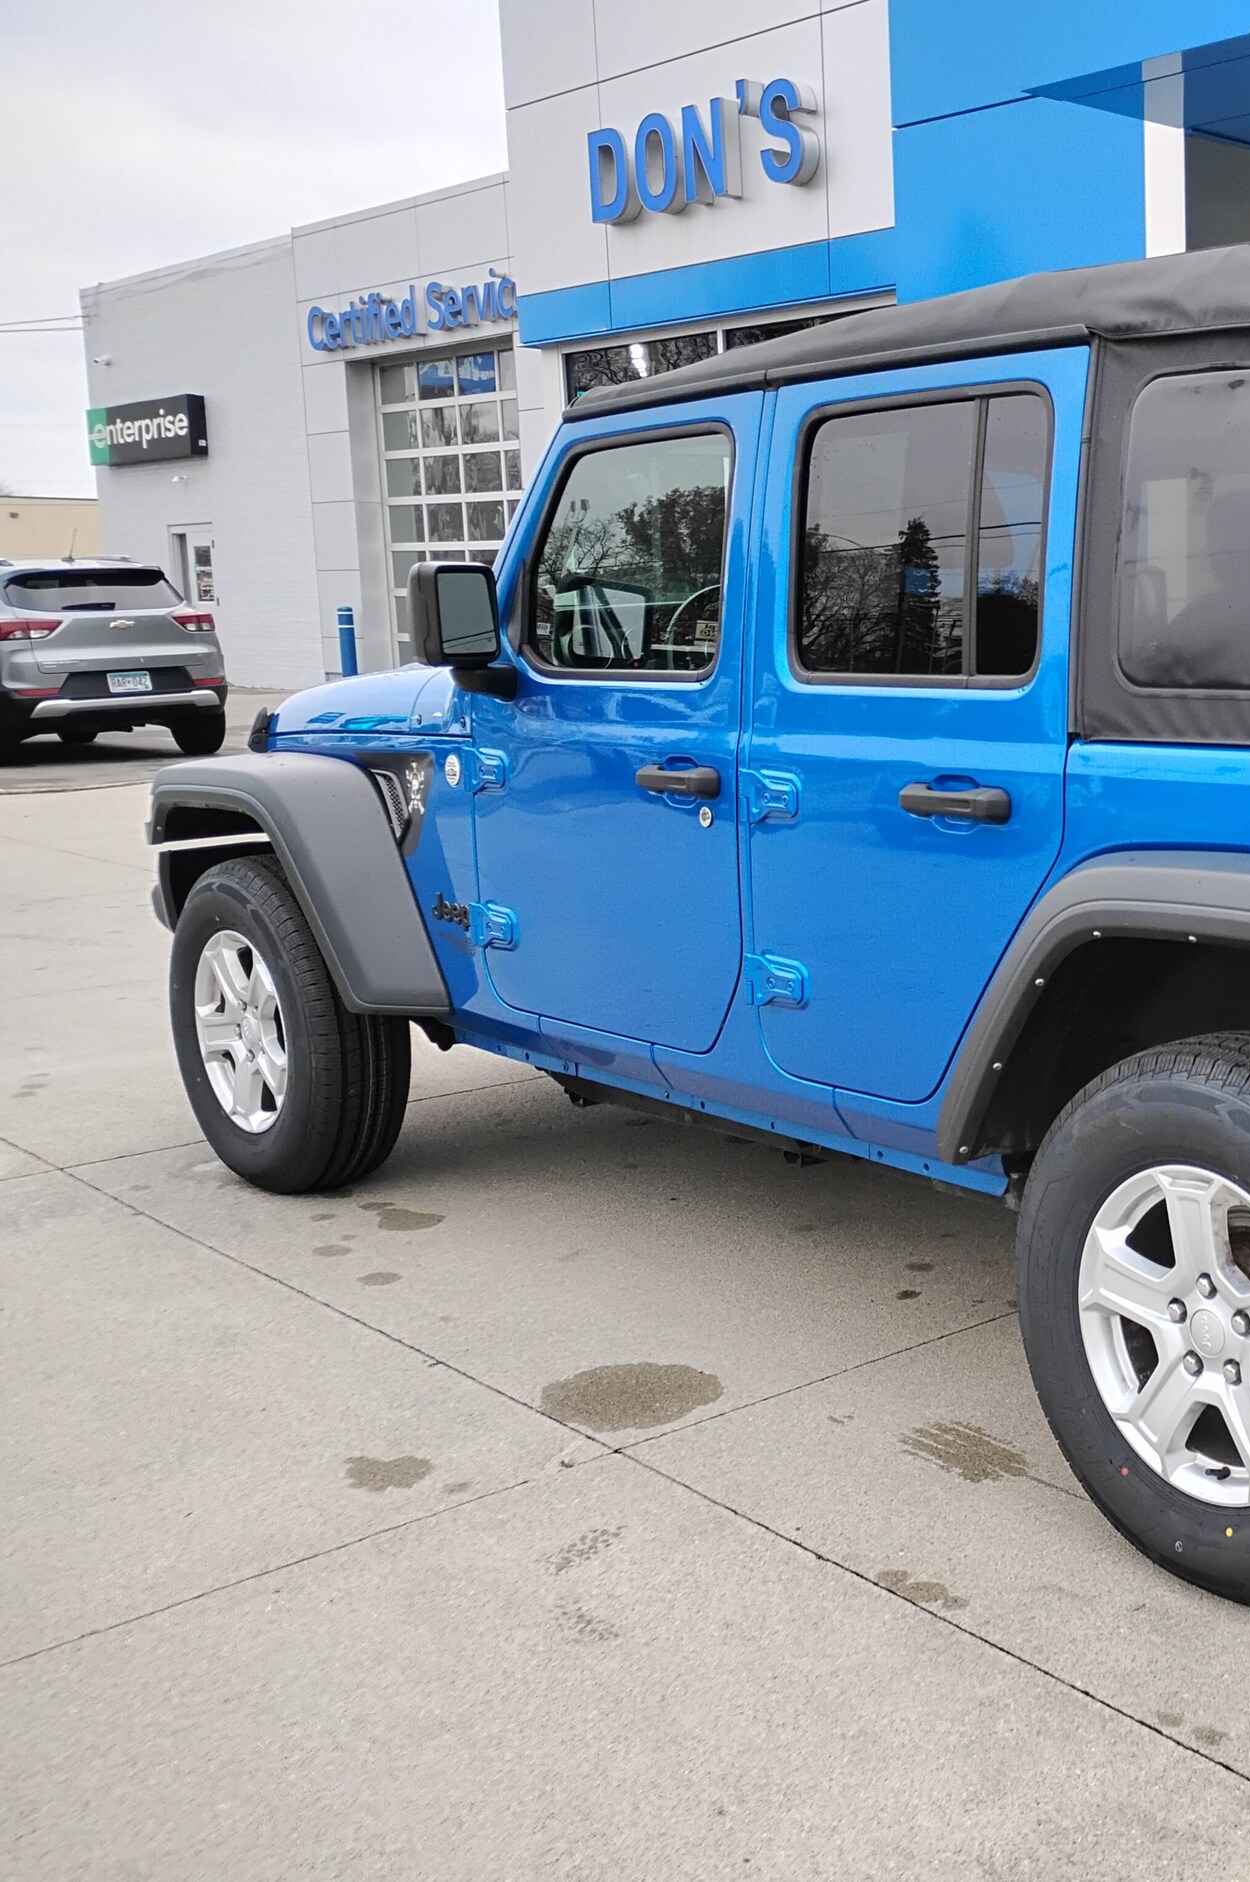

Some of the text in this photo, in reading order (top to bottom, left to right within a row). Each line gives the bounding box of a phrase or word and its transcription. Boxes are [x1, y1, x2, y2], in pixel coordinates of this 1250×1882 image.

[587, 78, 812, 224] DON'S
[308, 267, 518, 351] Certified Servic
[89, 408, 188, 448] enterprise
[432, 891, 470, 932] Jeep
